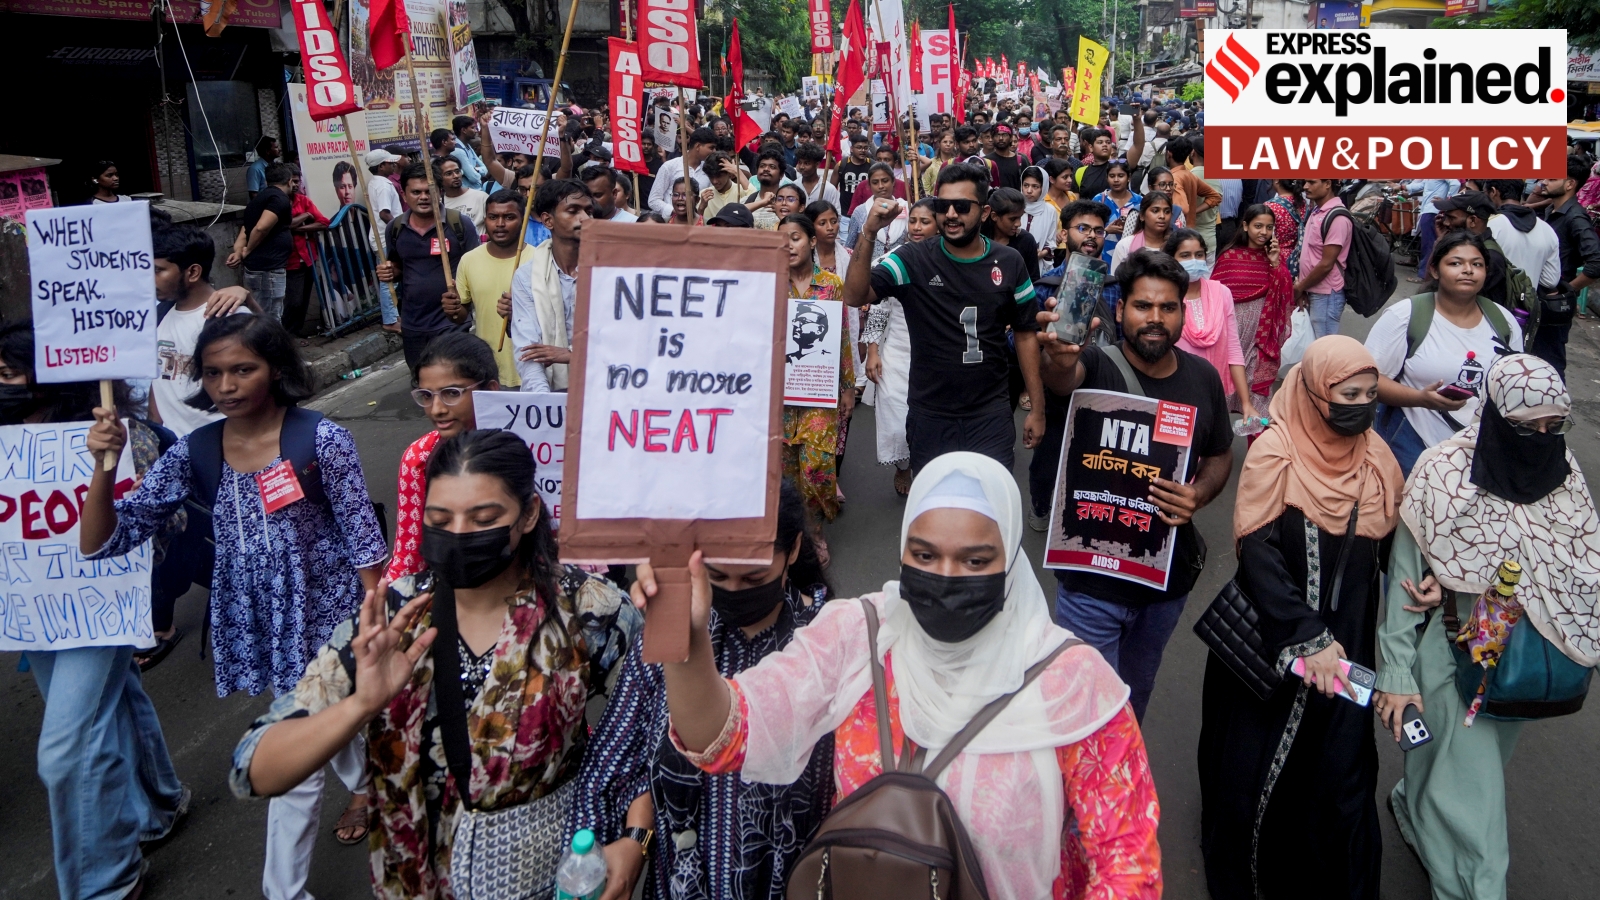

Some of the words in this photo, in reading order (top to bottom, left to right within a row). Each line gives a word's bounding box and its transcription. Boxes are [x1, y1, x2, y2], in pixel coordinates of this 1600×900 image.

[74, 7, 116, 15] Ahmed
[120, 10, 151, 18] Kidw
[98, 0, 143, 9] Spare
[148, 2, 186, 13] Prts,
[244, 9, 277, 18] Tubes
[412, 21, 441, 36] KOLKATA
[52, 46, 157, 60] EUROGRIP
[295, 0, 347, 107] IDSO
[411, 36, 450, 60] ATHYATRA
[1568, 53, 1592, 65] শহীদ
[928, 34, 950, 114] SFI
[492, 109, 532, 128] রাজা
[614, 51, 642, 163] AIDSO
[317, 118, 346, 133] Welcom
[306, 142, 327, 155] IMRAN
[327, 139, 366, 154] PRATAPRHI
[497, 143, 521, 152] AIDSO
[33, 216, 94, 247] WHEN
[66, 247, 152, 271] STUDENTS
[614, 273, 739, 321] NEET
[71, 307, 149, 335] HISTORY
[959, 306, 984, 364] 1
[658, 328, 685, 358] is
[606, 364, 648, 391] no
[666, 370, 752, 395] more
[503, 404, 567, 430] YOU
[608, 408, 734, 454] NEAT
[1100, 417, 1150, 456] NTA
[0, 427, 97, 484] WER
[1082, 449, 1128, 475] বাতিল
[1131, 461, 1161, 483] কর
[1076, 501, 1115, 523] রক্ষা
[1118, 507, 1152, 533] কর
[1091, 554, 1120, 571] AIDSO
[34, 593, 81, 643] IN
